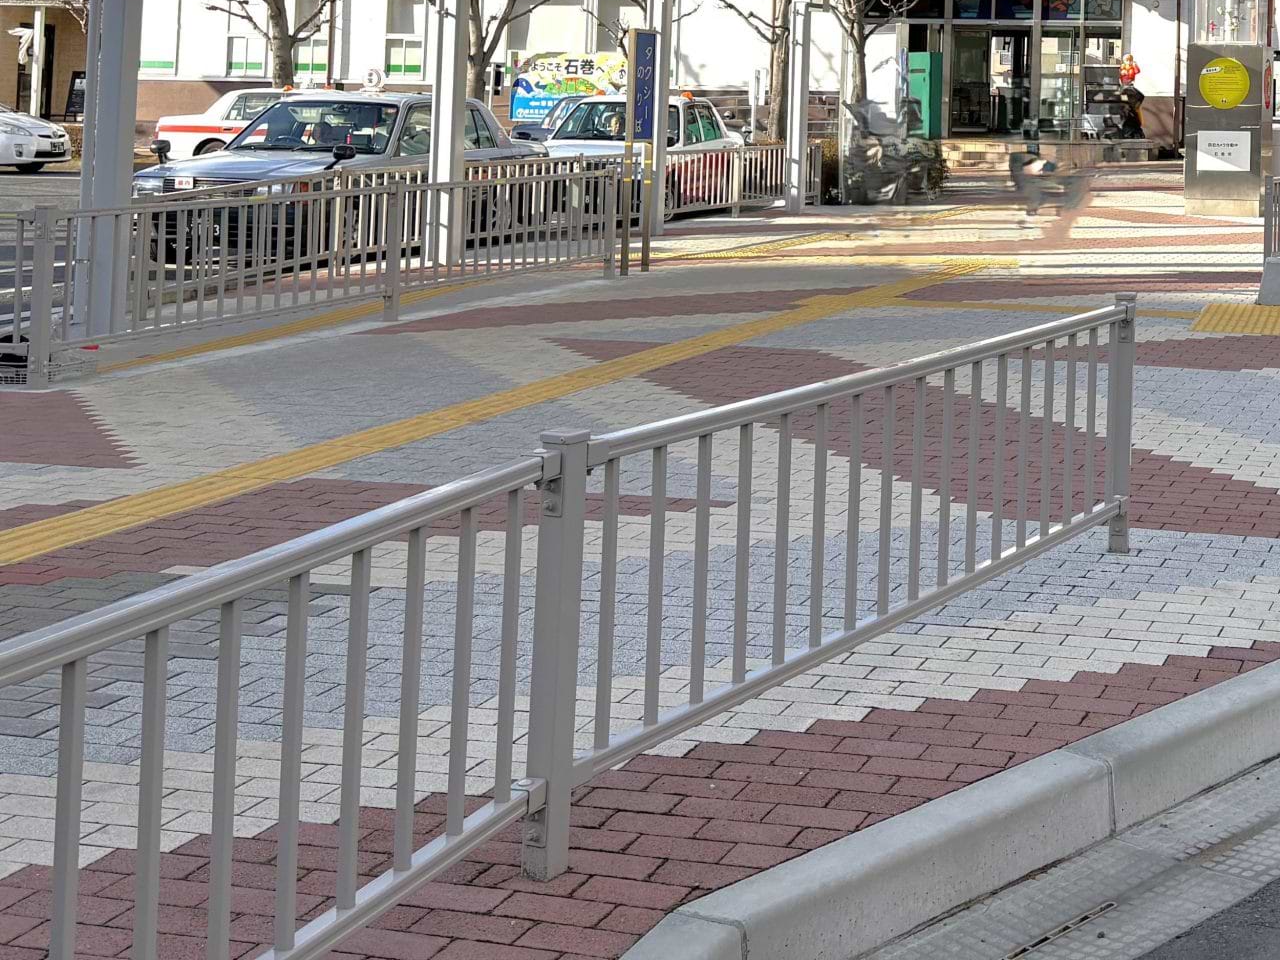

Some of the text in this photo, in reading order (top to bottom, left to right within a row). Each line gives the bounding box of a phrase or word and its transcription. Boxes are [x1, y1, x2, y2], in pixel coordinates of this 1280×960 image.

[635, 66, 644, 133] のりば
[643, 46, 653, 120] タクシー
